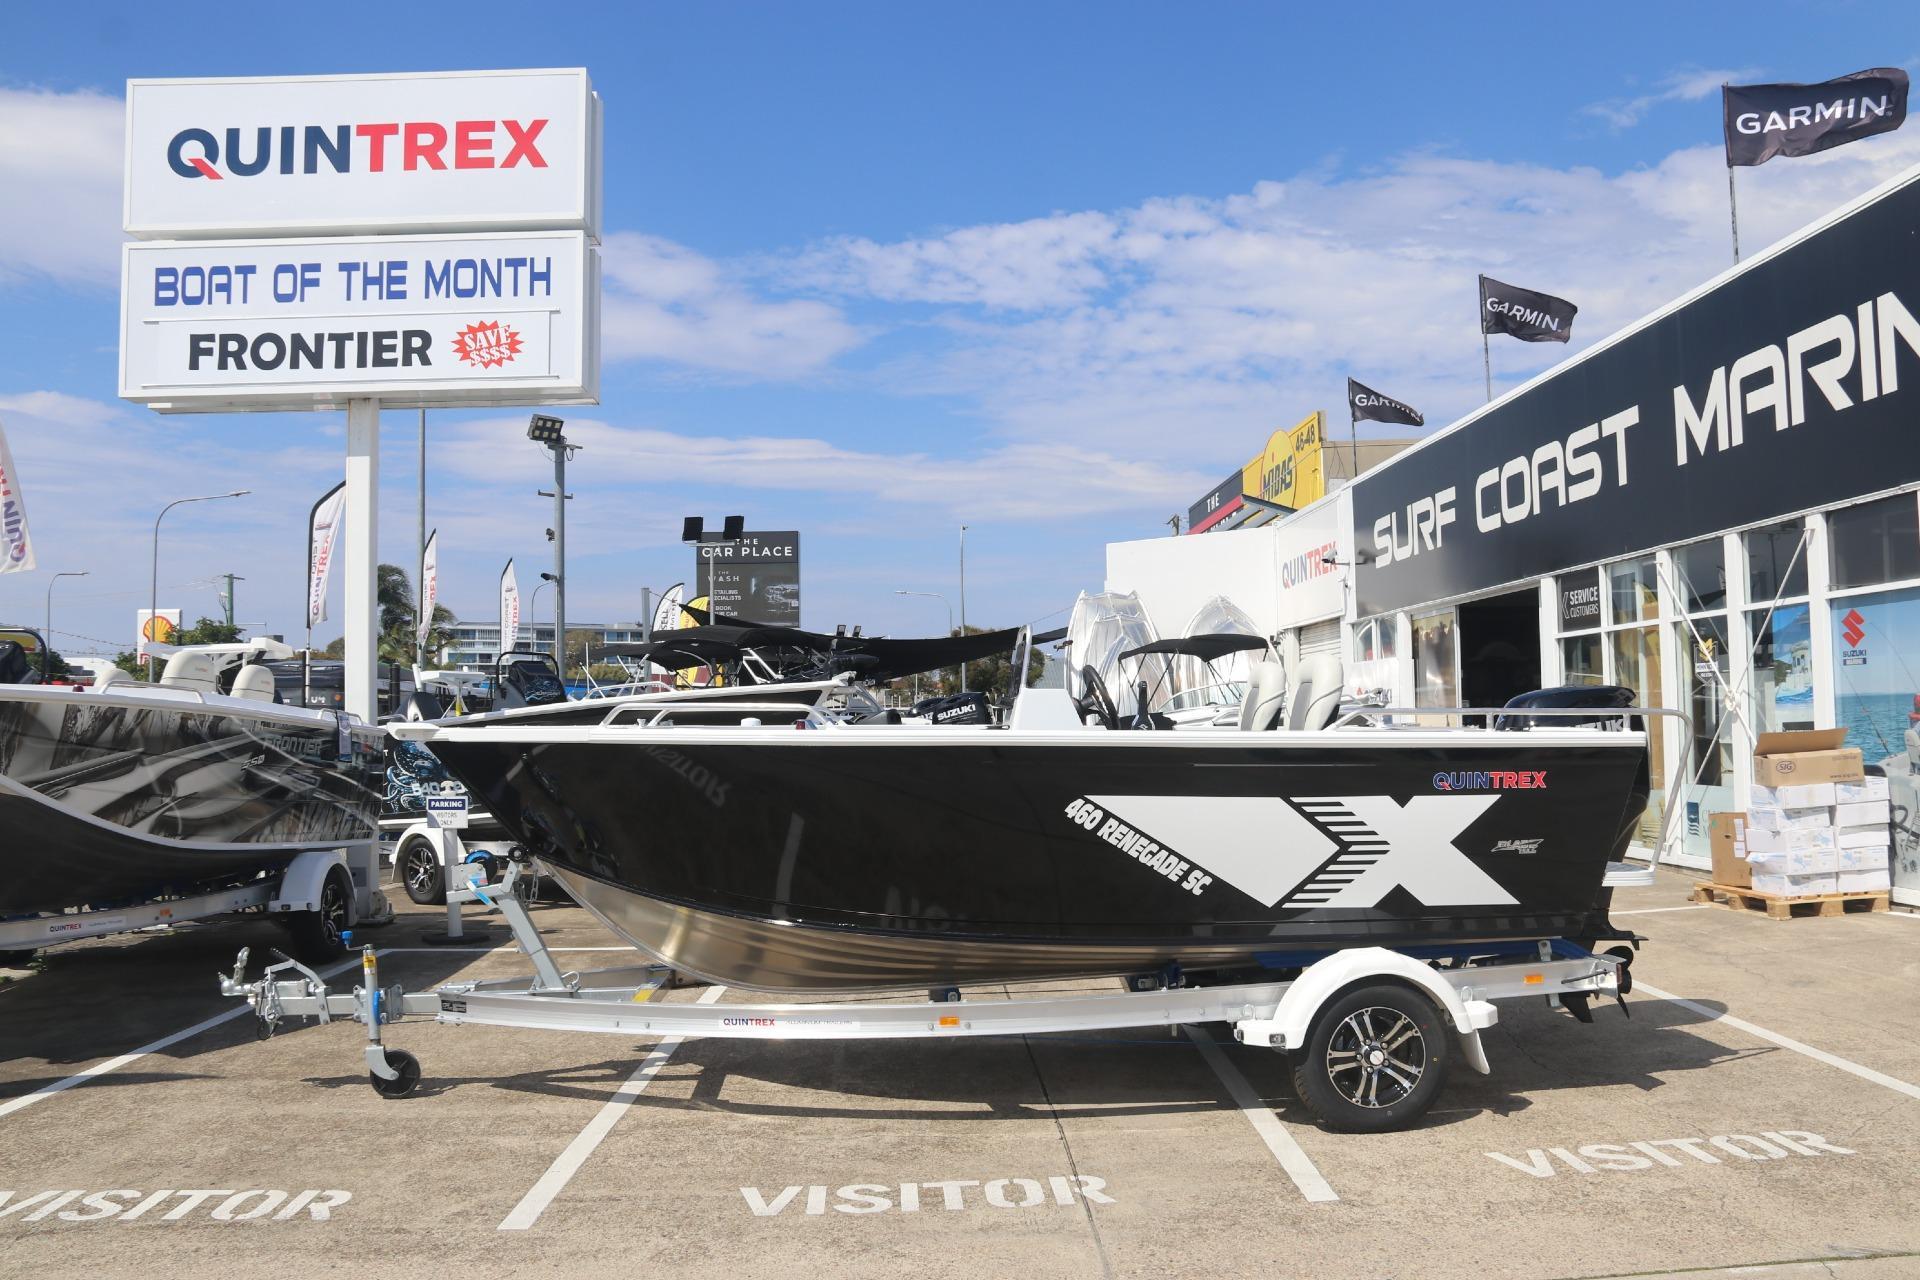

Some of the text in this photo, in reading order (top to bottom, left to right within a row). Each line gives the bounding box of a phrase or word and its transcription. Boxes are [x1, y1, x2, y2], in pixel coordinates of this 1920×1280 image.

[1736, 95, 1888, 135] GARMIN
[167, 119, 549, 180] QUINTREX
[154, 256, 552, 306] BOAT OF THE MONTH
[1486, 297, 1559, 331] GARMIN
[188, 328, 432, 371] FRONTIER
[463, 326, 511, 351] SAVE
[1206, 492, 1220, 513] THE
[1374, 486, 1457, 569] SURF
[1475, 404, 1640, 534] COAST
[702, 546, 793, 558] CAR PLACE
[1570, 586, 1599, 605] SERVICE
[1570, 603, 1599, 618] CUSTOMERS
[937, 703, 977, 720] SUZUKI
[1433, 770, 1547, 790] QUINTREX
[1064, 798, 1213, 896] 460 RENEGADE SC
[723, 1018, 775, 1026] QUINTREX
[1482, 1130, 1858, 1178] VISITOR
[739, 1174, 1118, 1217] VISITOR
